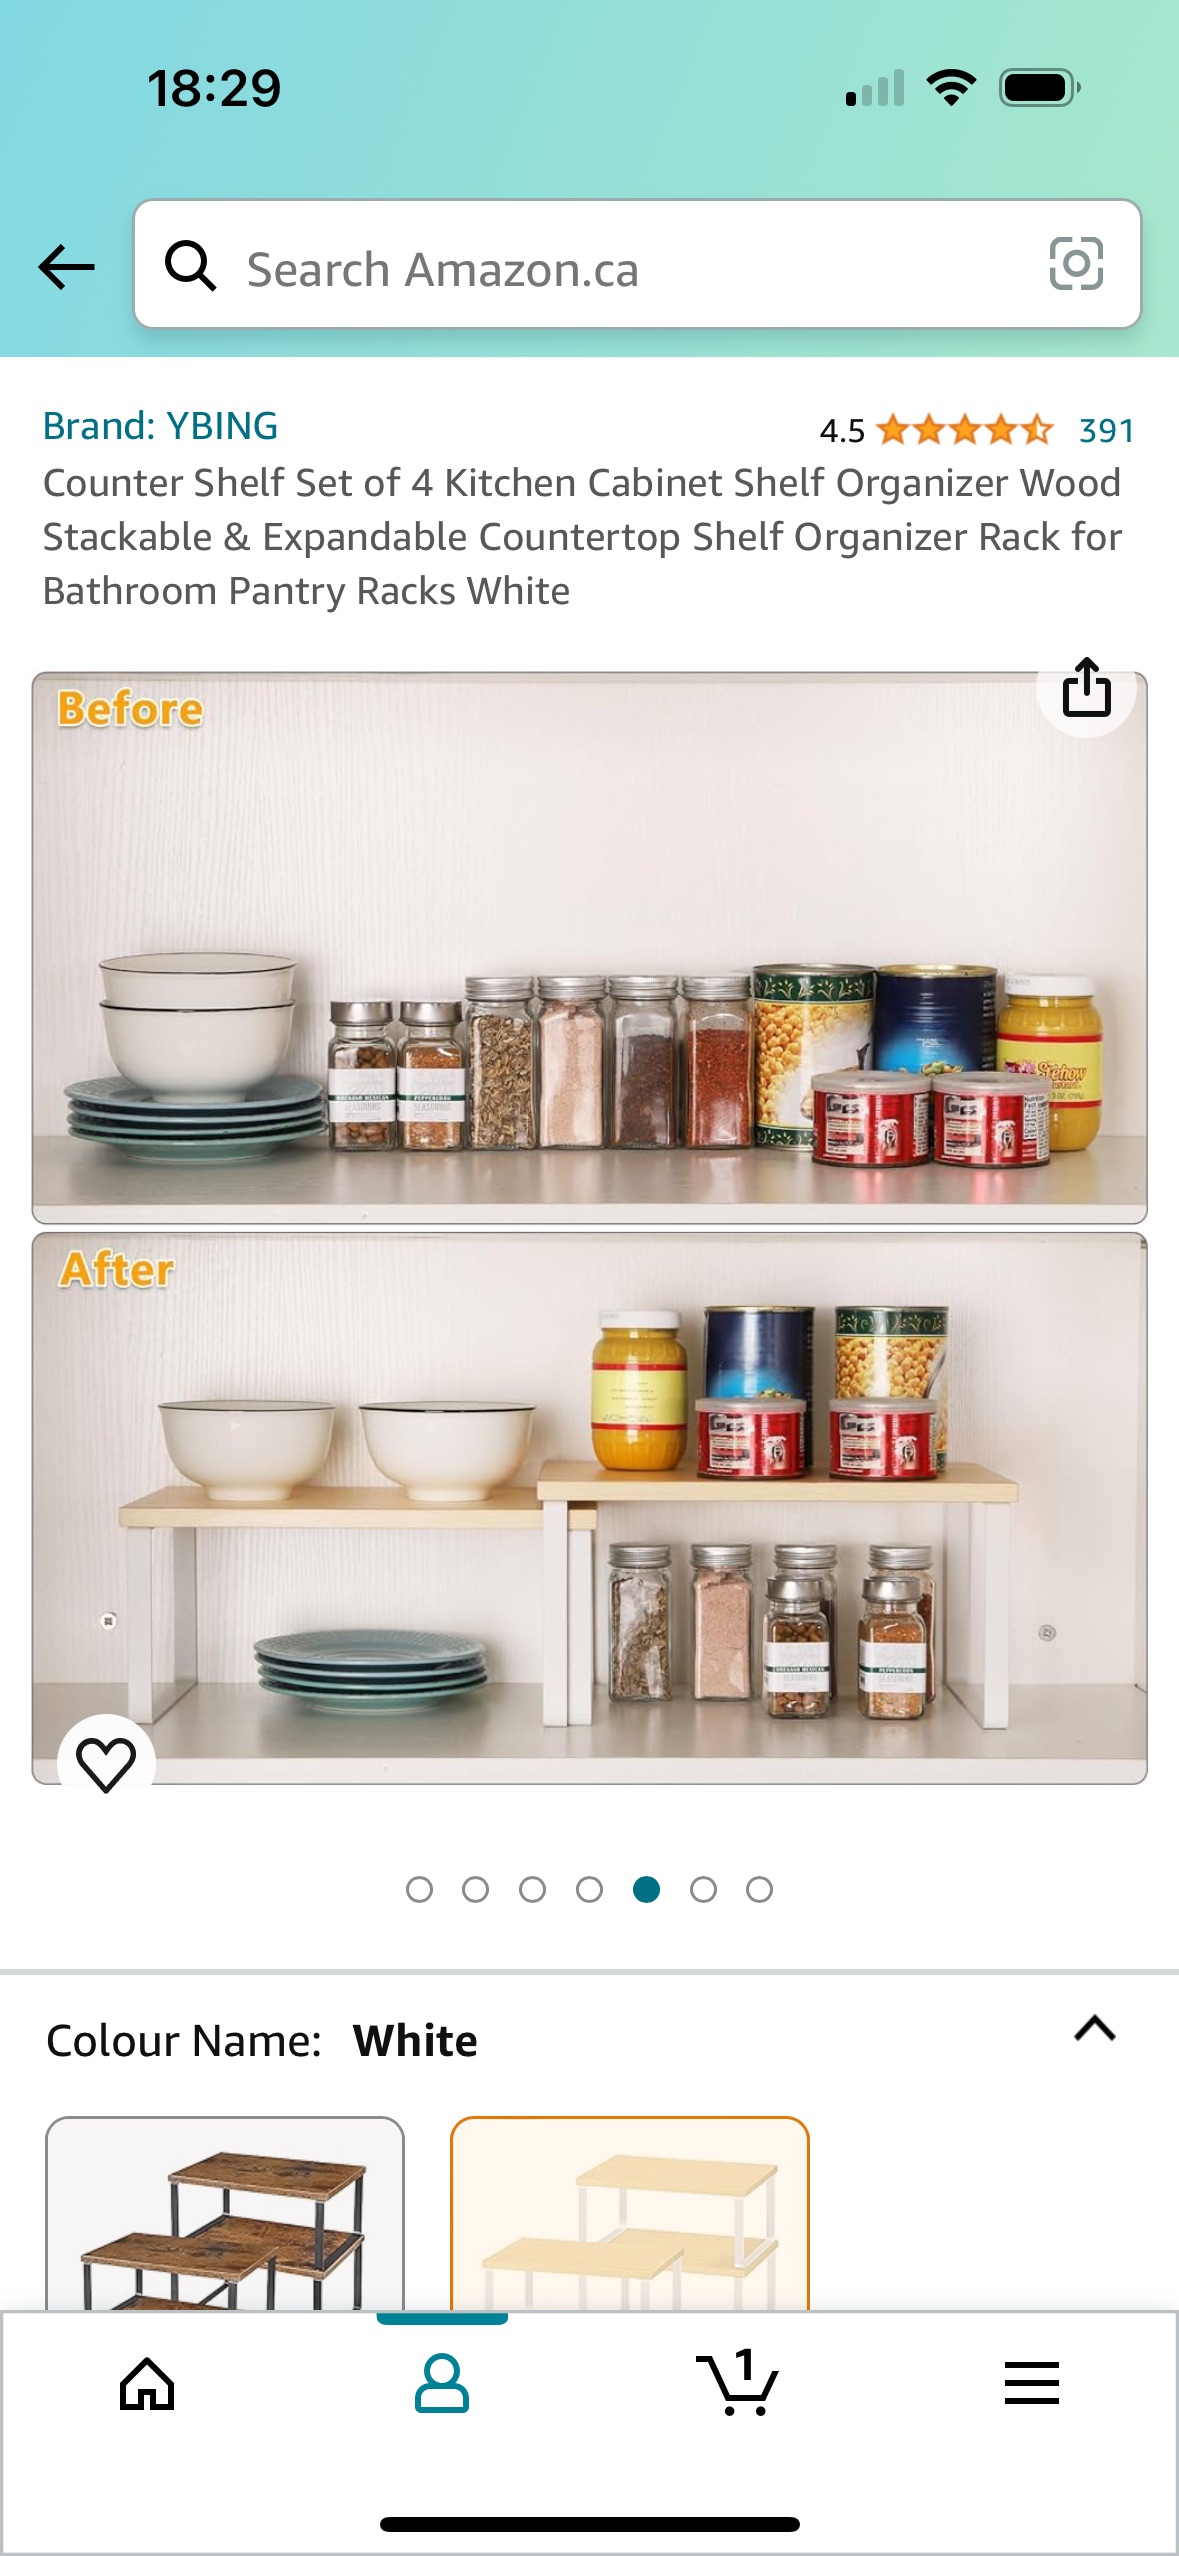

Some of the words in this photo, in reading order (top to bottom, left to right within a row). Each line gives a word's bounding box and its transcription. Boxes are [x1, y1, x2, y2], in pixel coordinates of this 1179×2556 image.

[149, 69, 280, 107] 18:29
[249, 250, 388, 287] Search
[405, 253, 637, 287] Amazon.ca
[45, 410, 154, 440] Brand:
[167, 411, 277, 440] YBING
[820, 419, 864, 443] 4.5
[1080, 418, 1131, 443] 391
[44, 468, 183, 497] Counter
[195, 467, 285, 497] Shelf
[297, 468, 352, 497] Set
[365, 466, 401, 497] of
[412, 469, 433, 496] 4
[447, 467, 574, 497] Kitchen
[589, 467, 722, 497] Cabinet
[735, 466, 825, 497] Shelf
[837, 468, 1008, 505] Organizer
[1020, 467, 1119, 497] Wood
[44, 521, 211, 551] Stackable
[224, 522, 250, 551] &
[265, 521, 466, 558] Expandable
[480, 522, 679, 558] Countertop
[694, 520, 784, 551] Shelf
[795, 522, 967, 559] Organizer
[981, 521, 1060, 551] Rack
[1072, 521, 1122, 551] for
[45, 575, 215, 605] Bathroom
[231, 577, 345, 613] Pantry
[359, 575, 455, 605] Racks
[467, 575, 569, 605] White
[48, 2022, 180, 2057] Colour
[195, 2025, 320, 2057] Name:
[353, 2022, 477, 2057] White
[736, 2349, 752, 2381] 1
